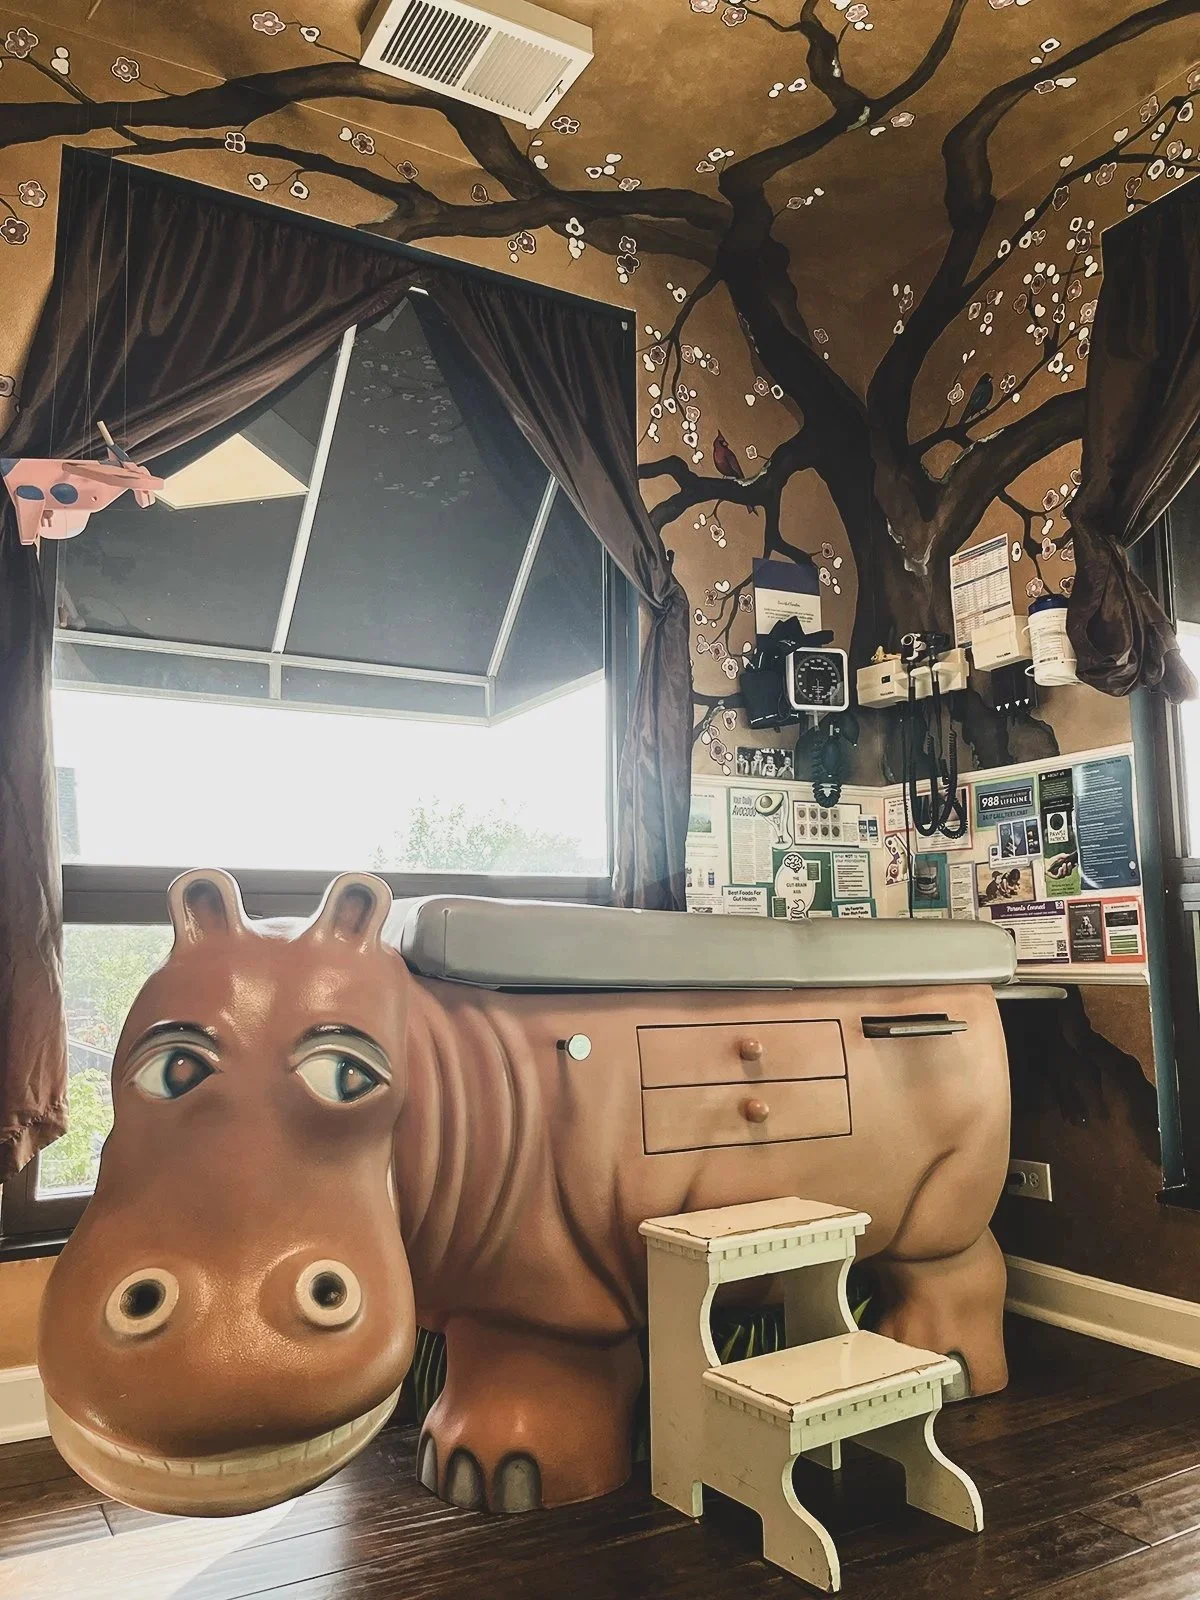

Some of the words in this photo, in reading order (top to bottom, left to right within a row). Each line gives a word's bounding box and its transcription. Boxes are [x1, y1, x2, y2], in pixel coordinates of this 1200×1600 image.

[981, 796, 999, 807] 988
[1000, 795, 1028, 805] LIFELINE
[1026, 903, 1046, 911] Connect
